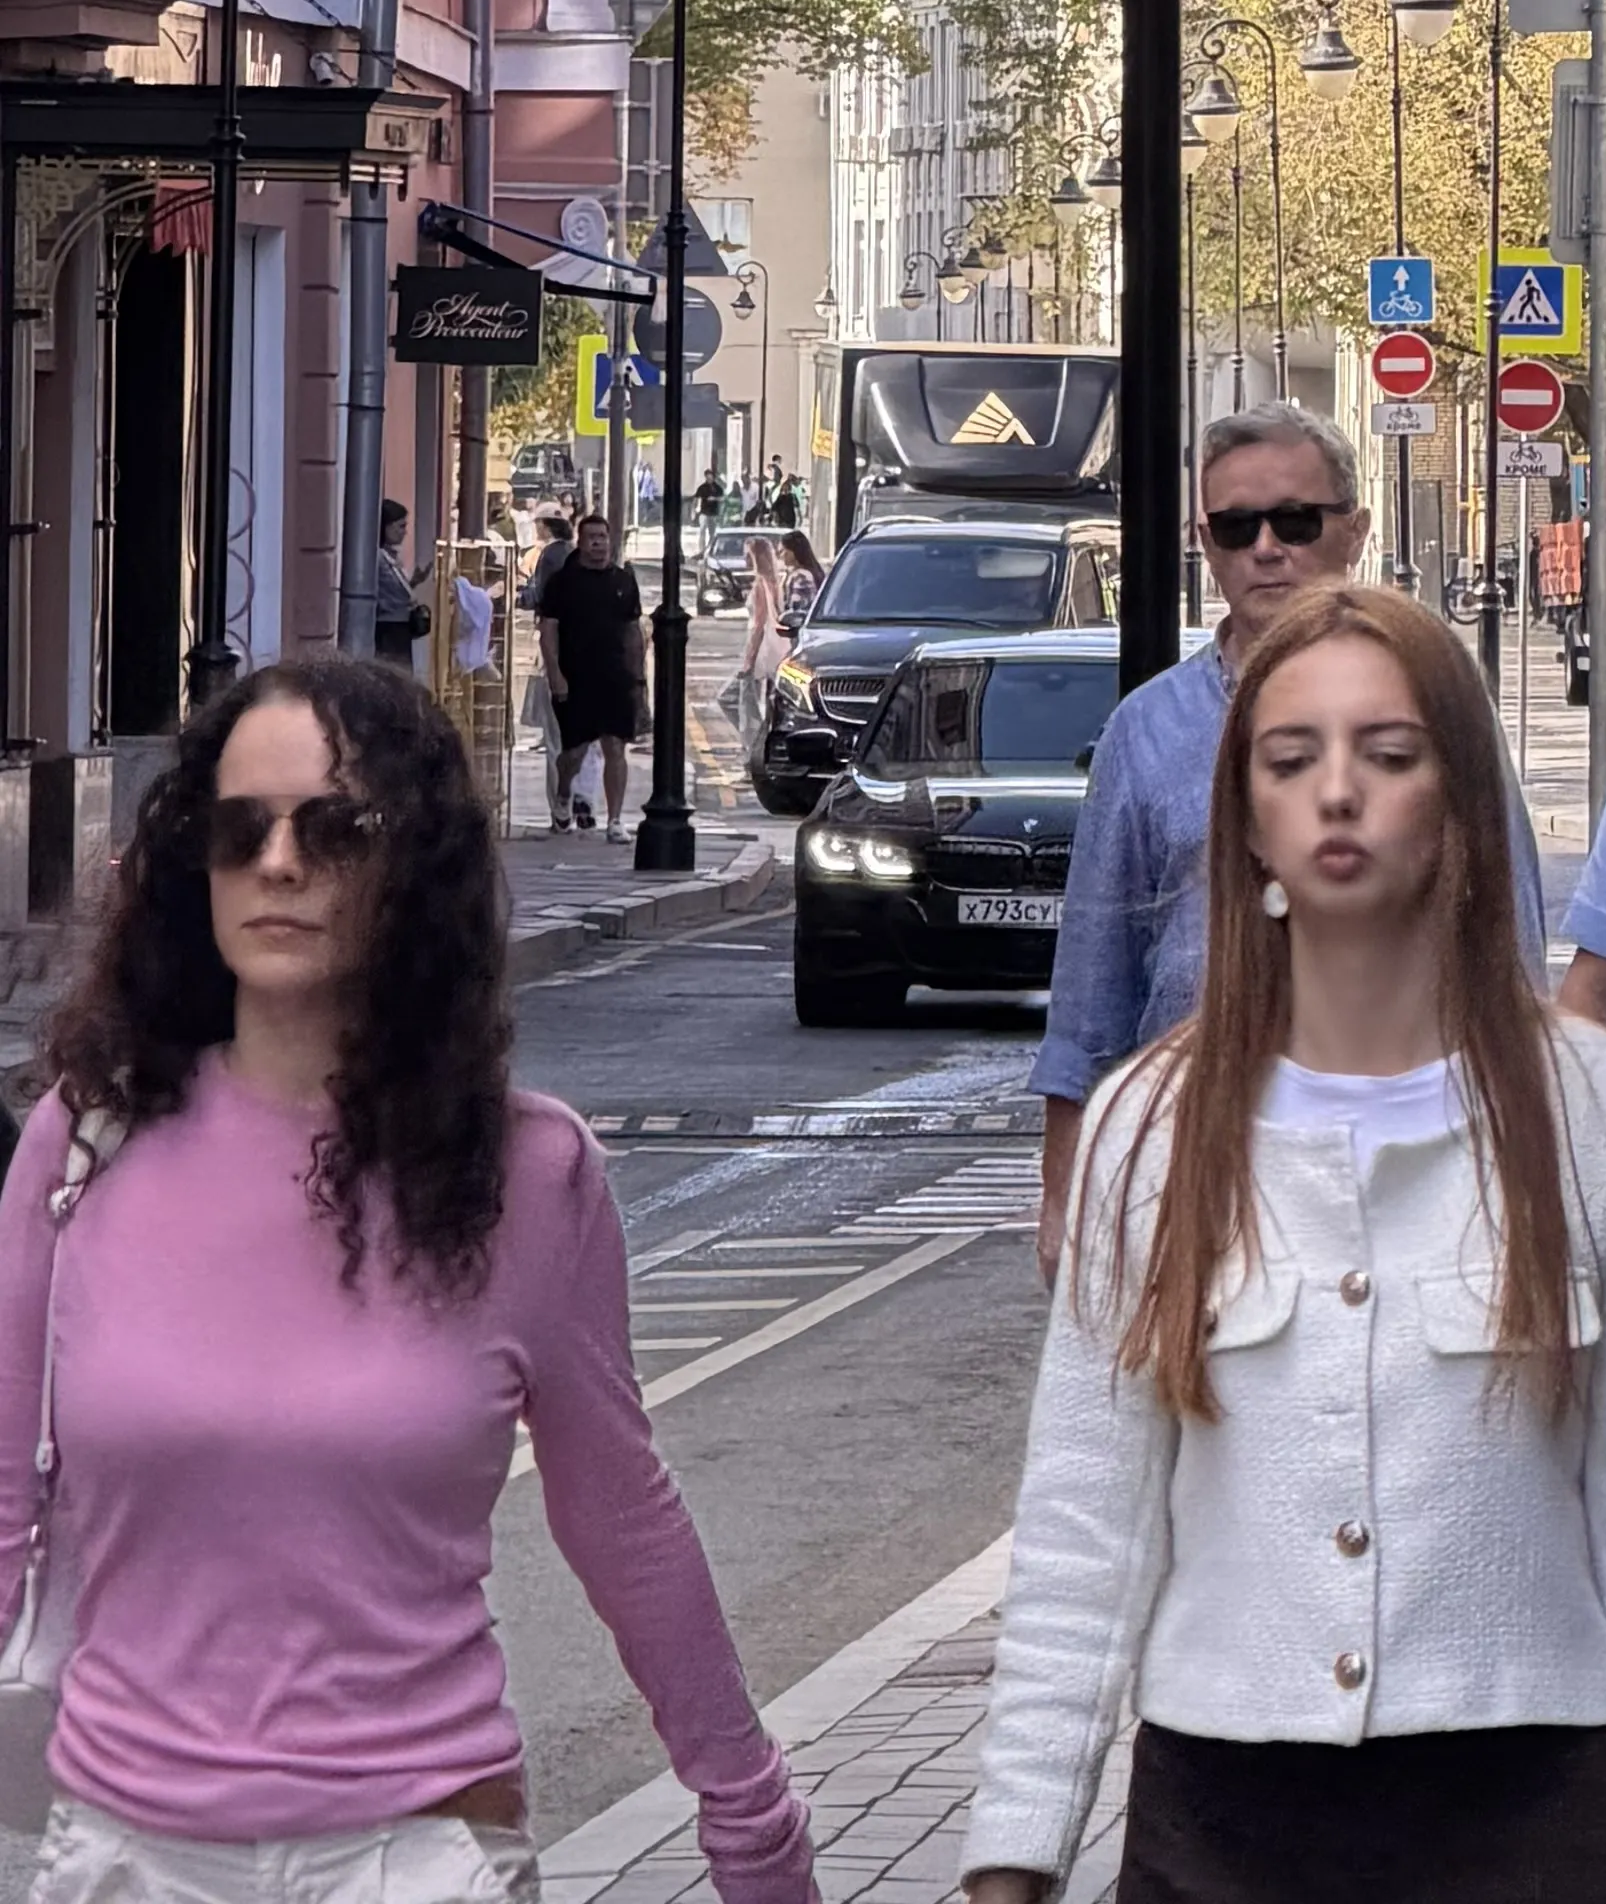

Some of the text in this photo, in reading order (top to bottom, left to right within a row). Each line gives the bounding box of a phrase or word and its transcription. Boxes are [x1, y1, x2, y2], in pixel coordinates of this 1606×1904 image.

[433, 292, 527, 326] Agent
[410, 311, 527, 338] Provocateur
[1505, 464, 1547, 475] КРОМЕ
